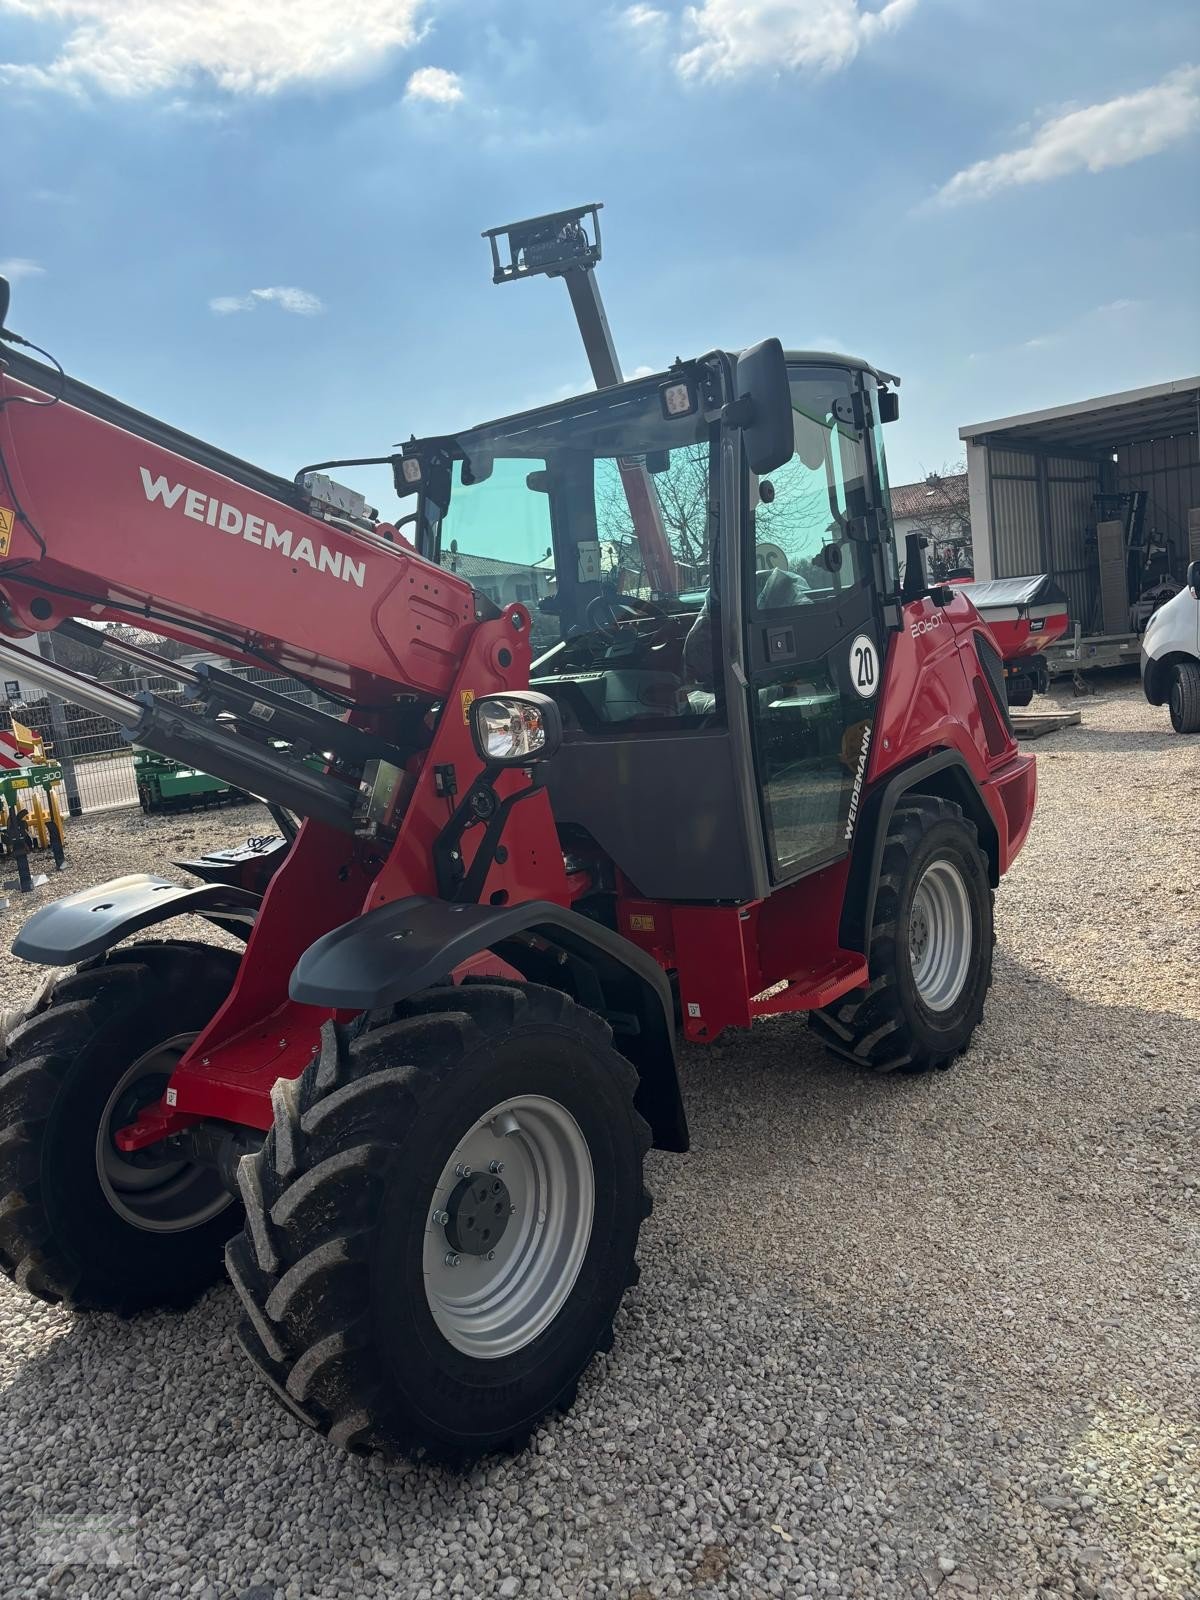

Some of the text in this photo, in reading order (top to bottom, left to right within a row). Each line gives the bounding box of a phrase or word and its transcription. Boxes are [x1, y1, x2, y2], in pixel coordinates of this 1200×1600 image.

[139, 466, 366, 588] WEIDEMANN
[910, 612, 944, 639] 2060T
[855, 647, 874, 687] 20
[34, 771, 61, 784] C 300
[844, 725, 872, 841] WEIDEMANN
